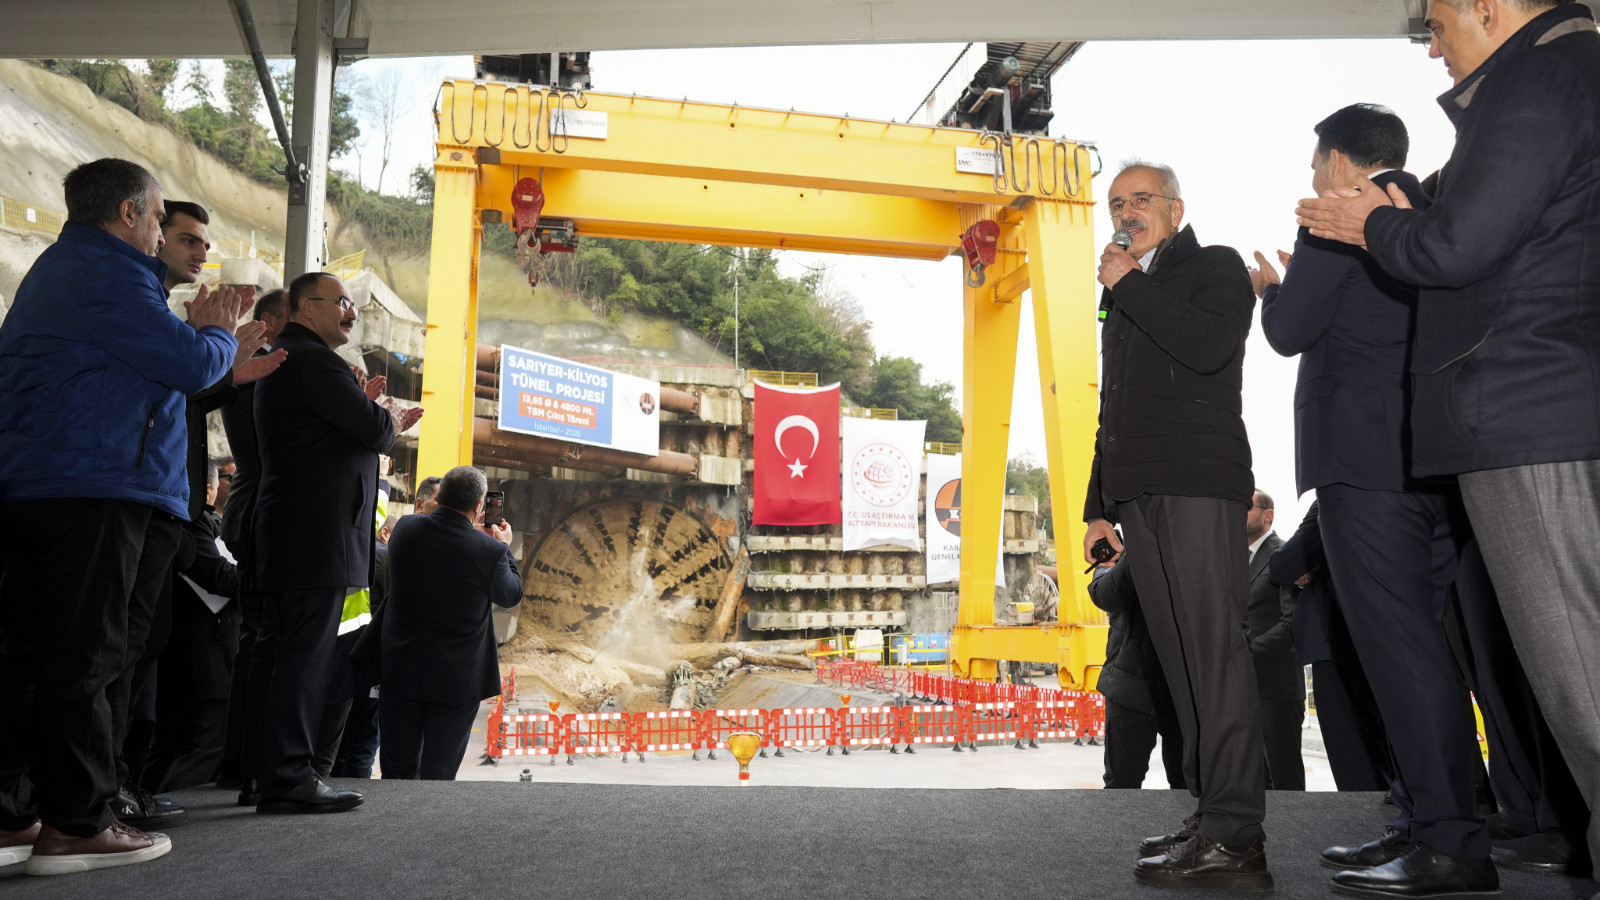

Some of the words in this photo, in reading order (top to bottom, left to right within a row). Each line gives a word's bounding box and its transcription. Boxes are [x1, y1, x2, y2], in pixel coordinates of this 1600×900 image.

[508, 355, 608, 388] SARIYER-KİLYOS
[510, 371, 553, 394] TÜNEL
[556, 383, 605, 405] PROJESİ
[522, 394, 543, 405] 13,65
[561, 402, 581, 413] 4800
[527, 406, 545, 417] TBM
[566, 413, 589, 426] Töreni
[534, 420, 560, 434] İstanbul
[565, 428, 581, 437] 2026
[861, 511, 906, 521] ULAŞTIRMA
[931, 553, 955, 561] GENEL
